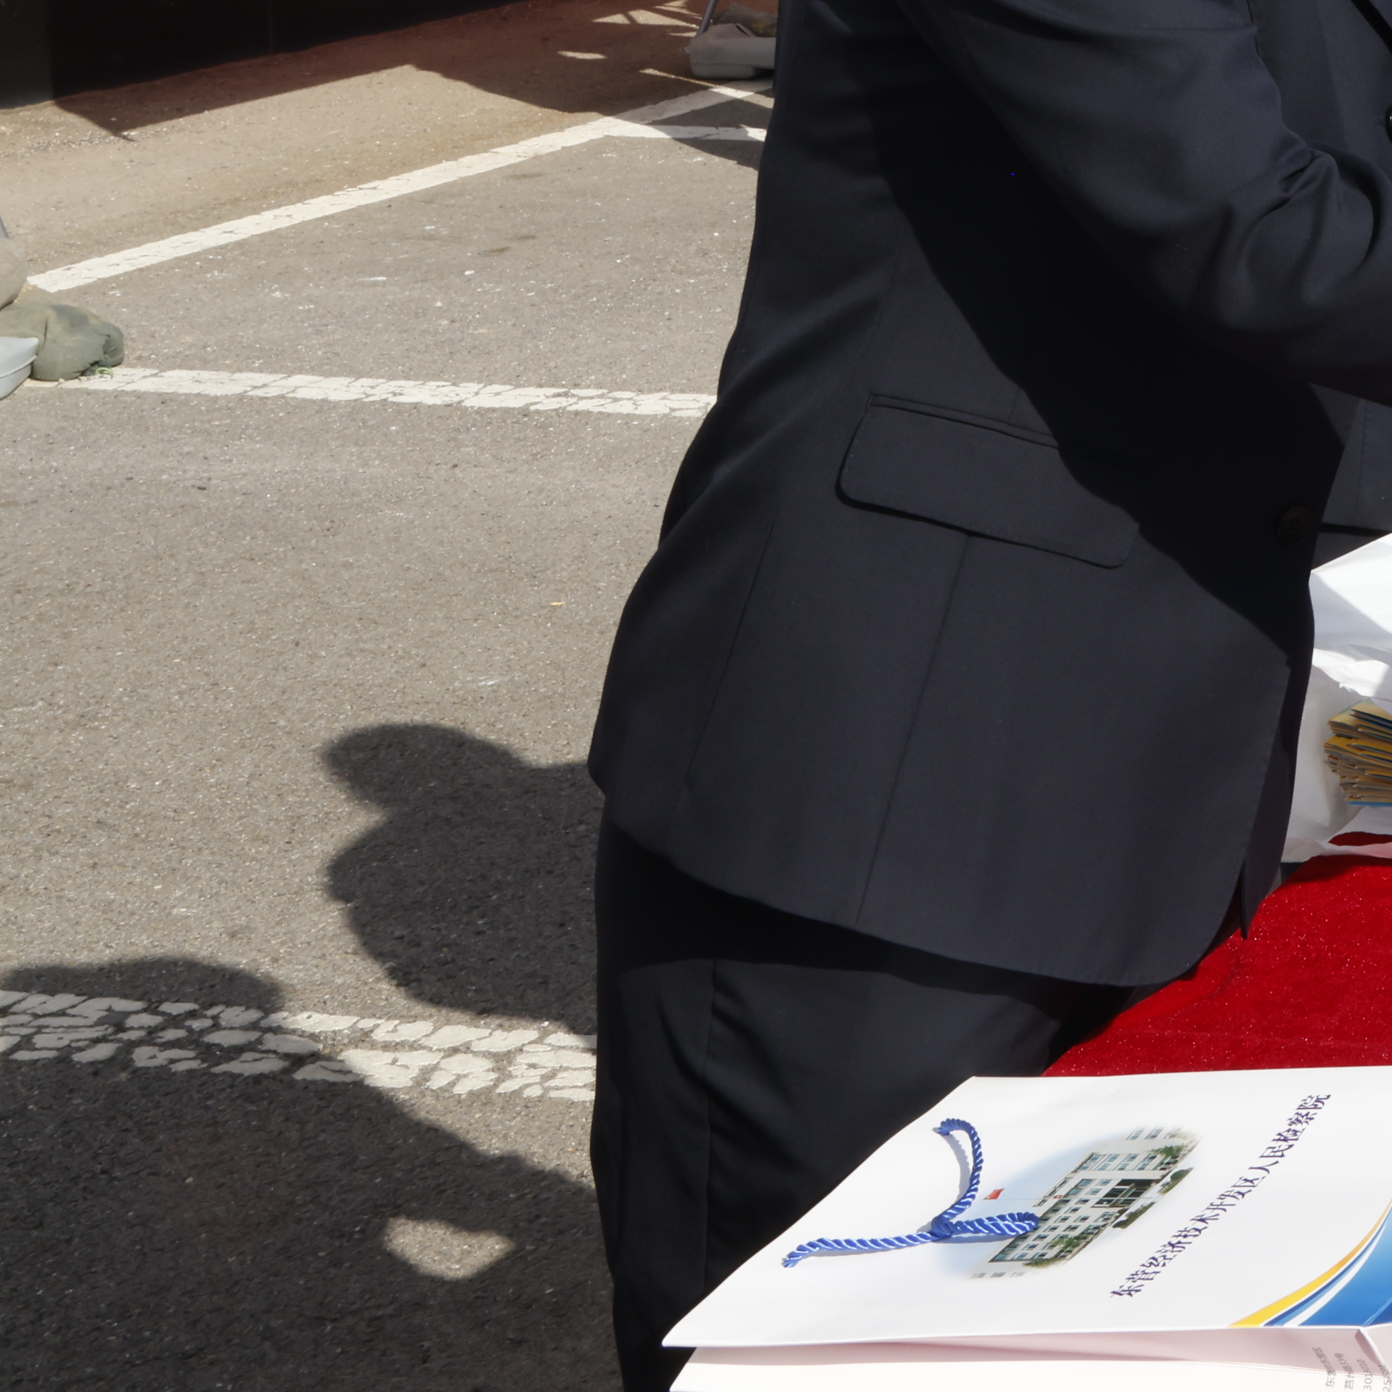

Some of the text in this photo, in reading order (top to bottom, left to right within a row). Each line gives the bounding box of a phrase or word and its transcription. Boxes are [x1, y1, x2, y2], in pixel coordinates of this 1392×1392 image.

[1109, 1092, 1332, 1300] 东营经济技术开发区人民检察院
